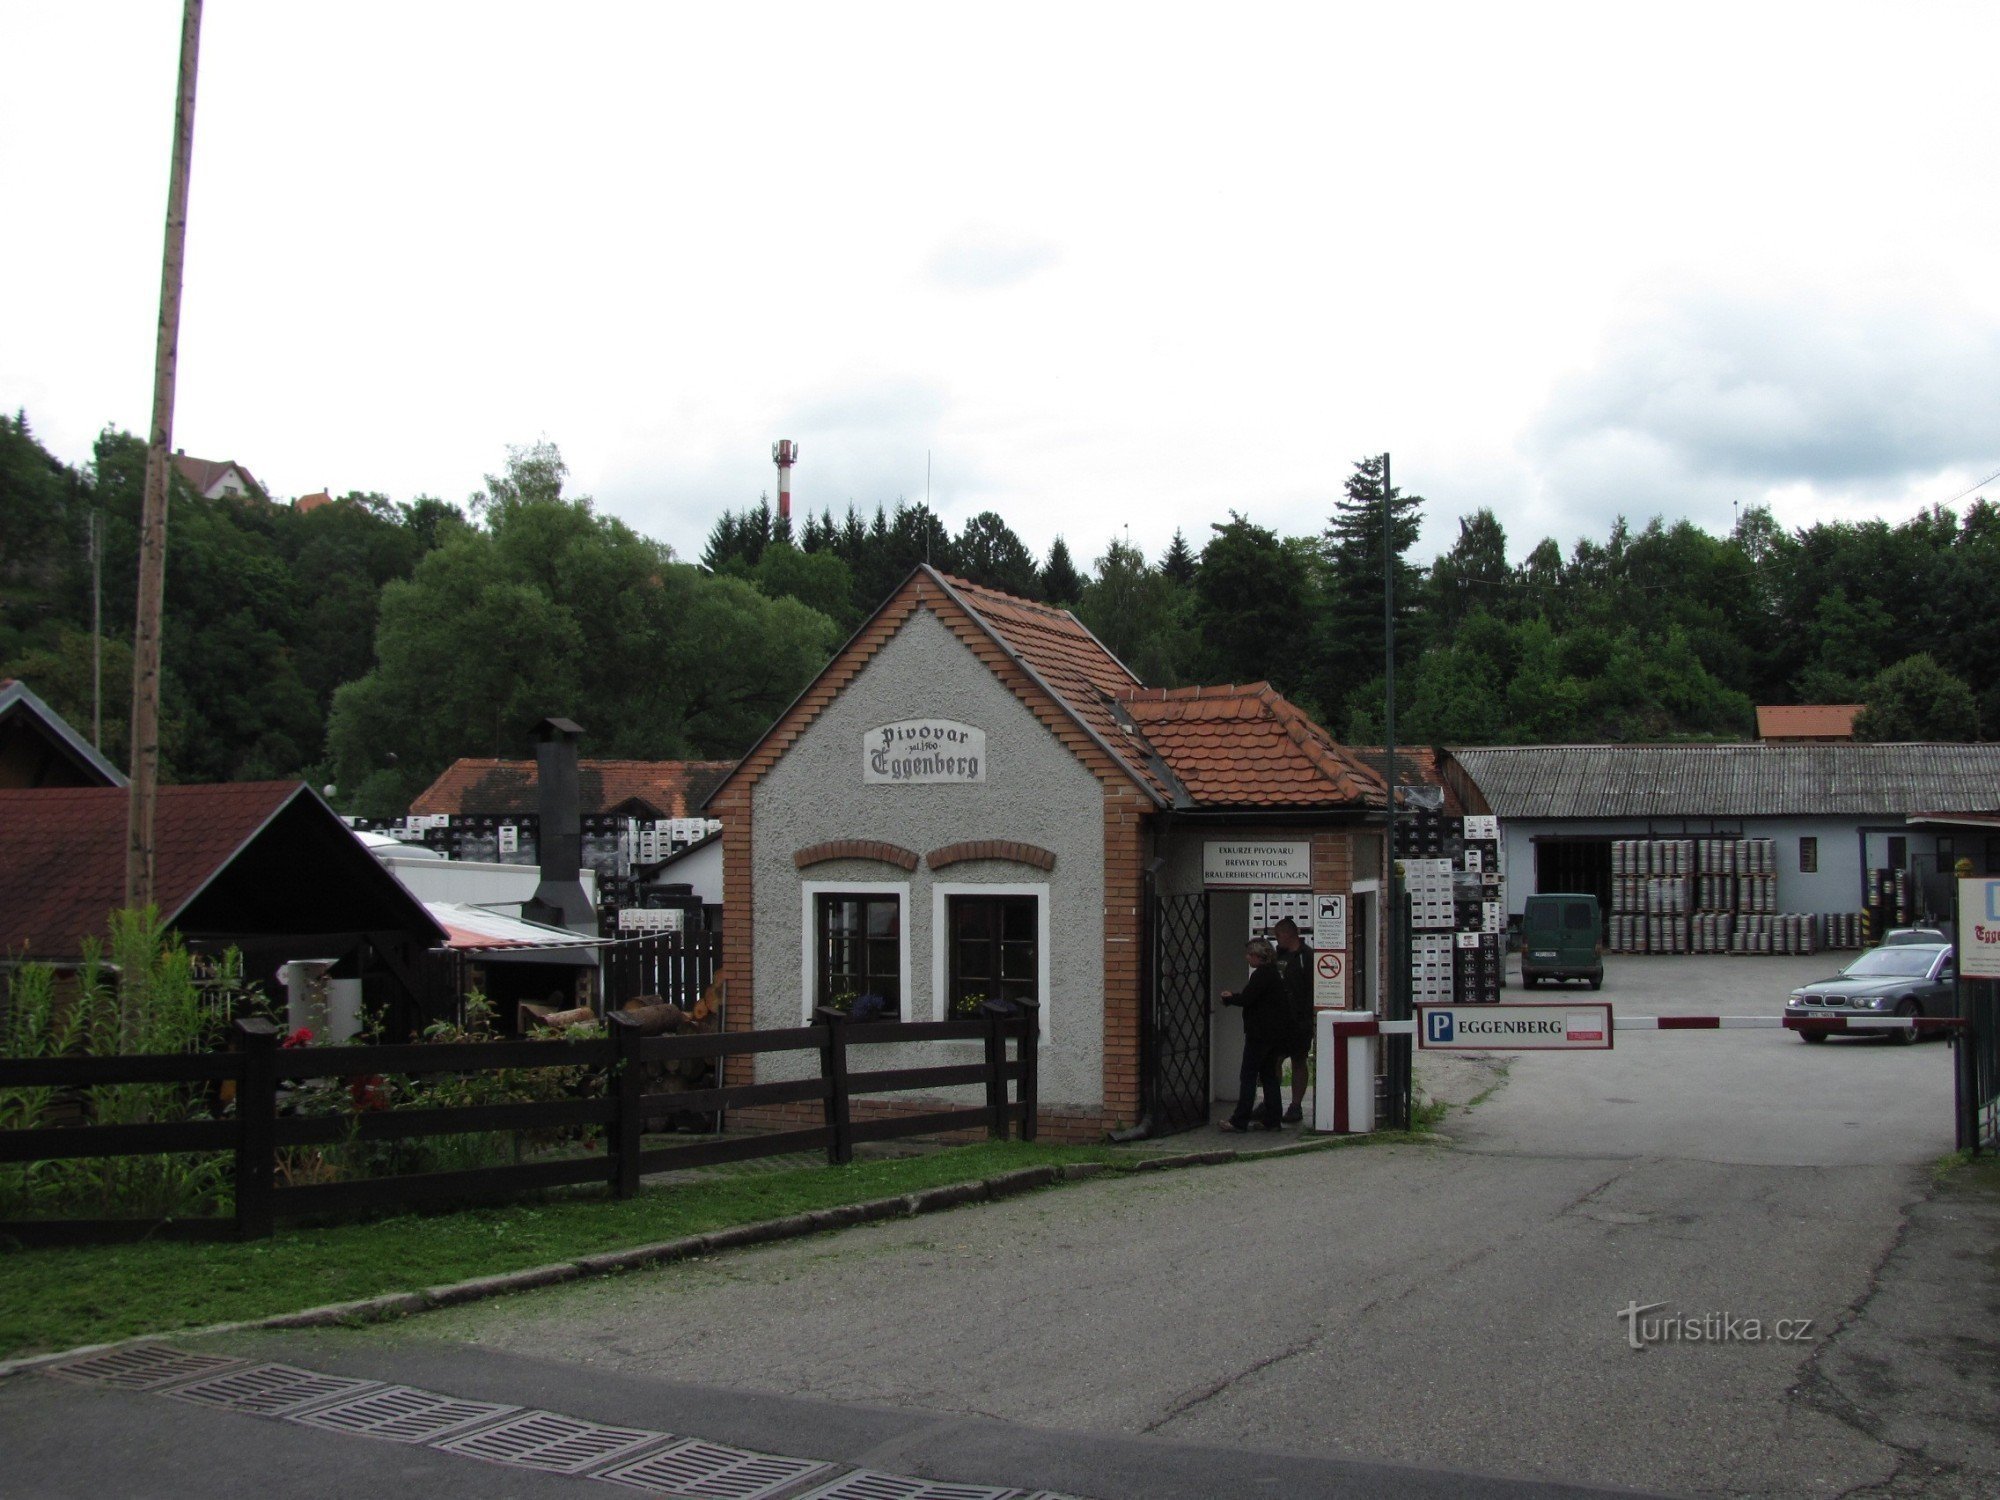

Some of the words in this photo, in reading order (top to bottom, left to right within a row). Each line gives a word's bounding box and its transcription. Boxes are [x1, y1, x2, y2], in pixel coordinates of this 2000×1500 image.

[870, 747, 979, 780] Eggenberg
[1253, 847, 1294, 855] PIVOVARU
[1205, 871, 1309, 879] BRAUEREIBESICHTIGUNGEN
[1433, 1015, 1450, 1039] P
[1458, 1020, 1562, 1034] EGGENBERG
